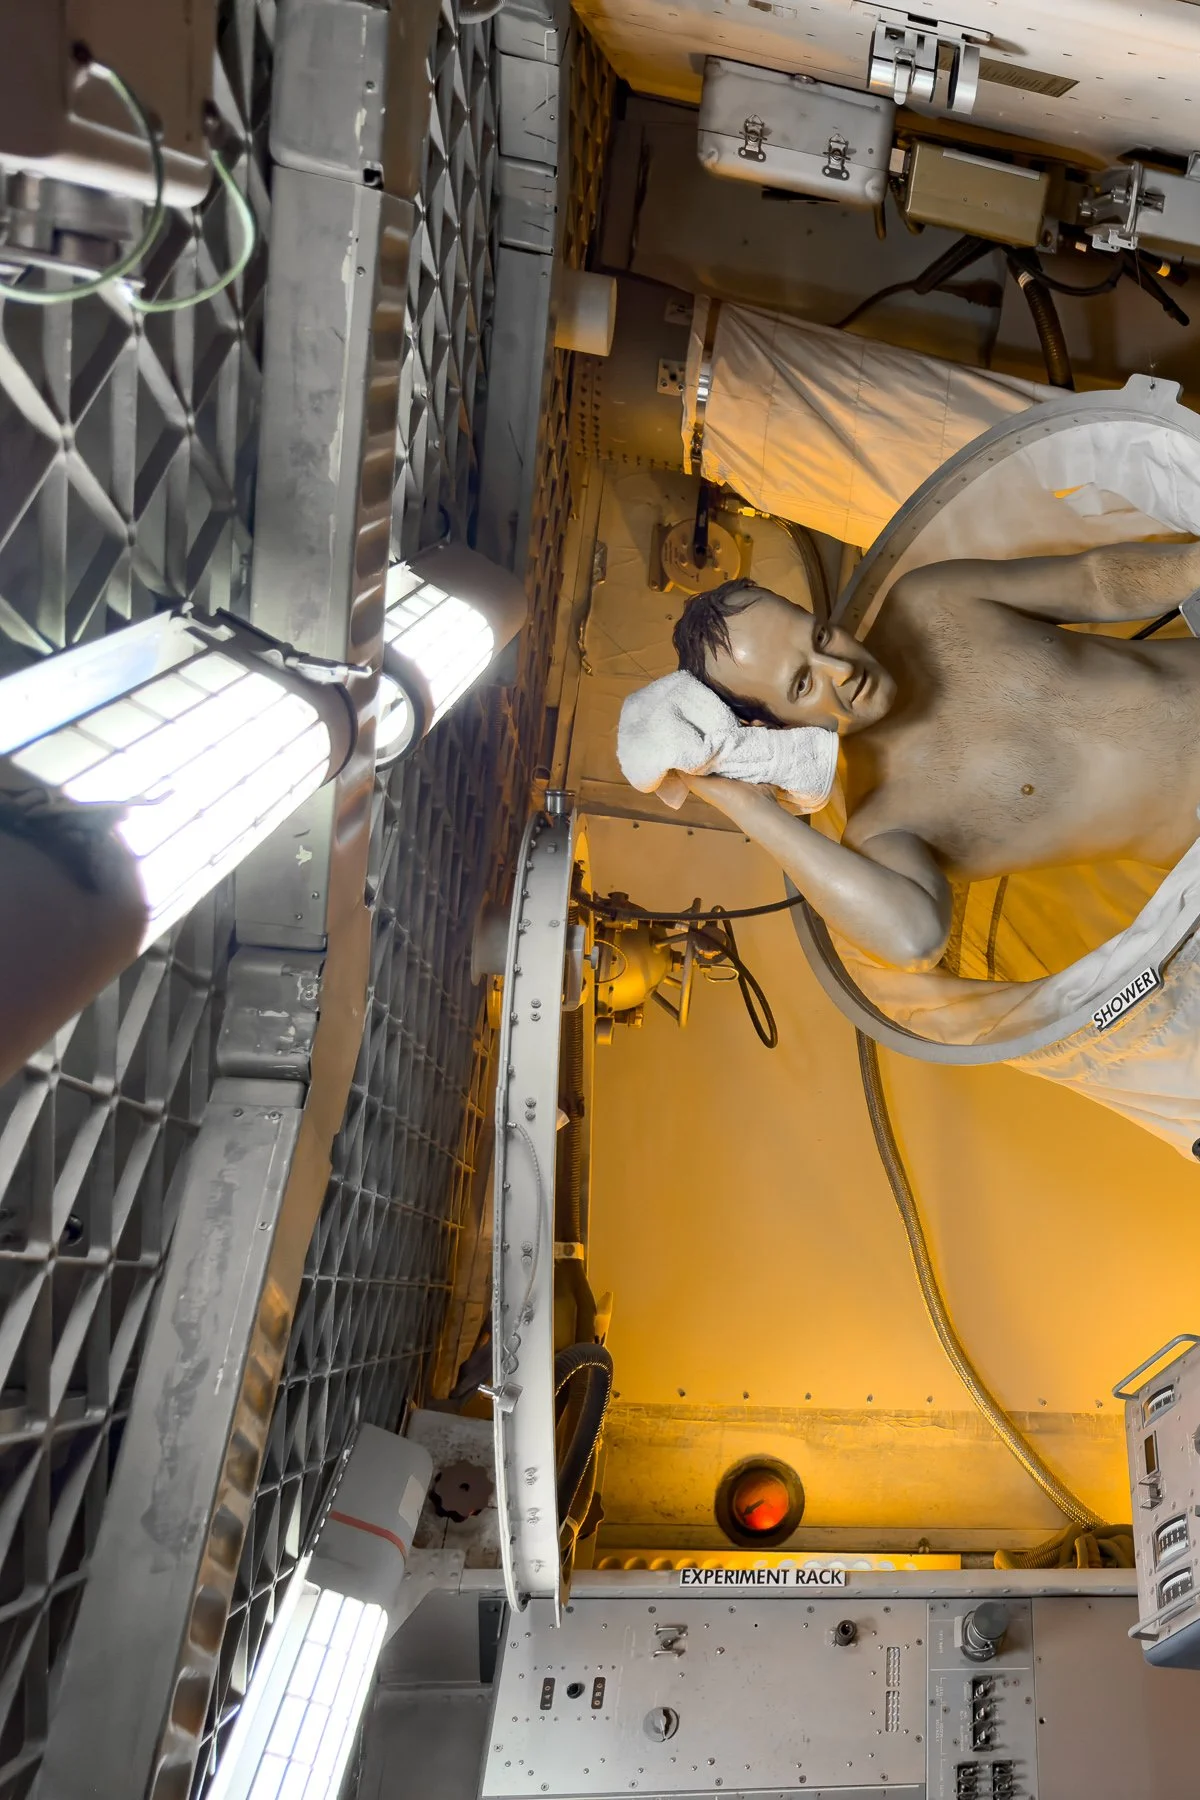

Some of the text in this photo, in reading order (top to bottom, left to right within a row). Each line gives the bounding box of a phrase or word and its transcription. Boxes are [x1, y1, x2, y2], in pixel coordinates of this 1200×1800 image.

[1093, 971, 1153, 1028] SHOWER
[681, 1569, 843, 1584] EXPERIMENT RACK
